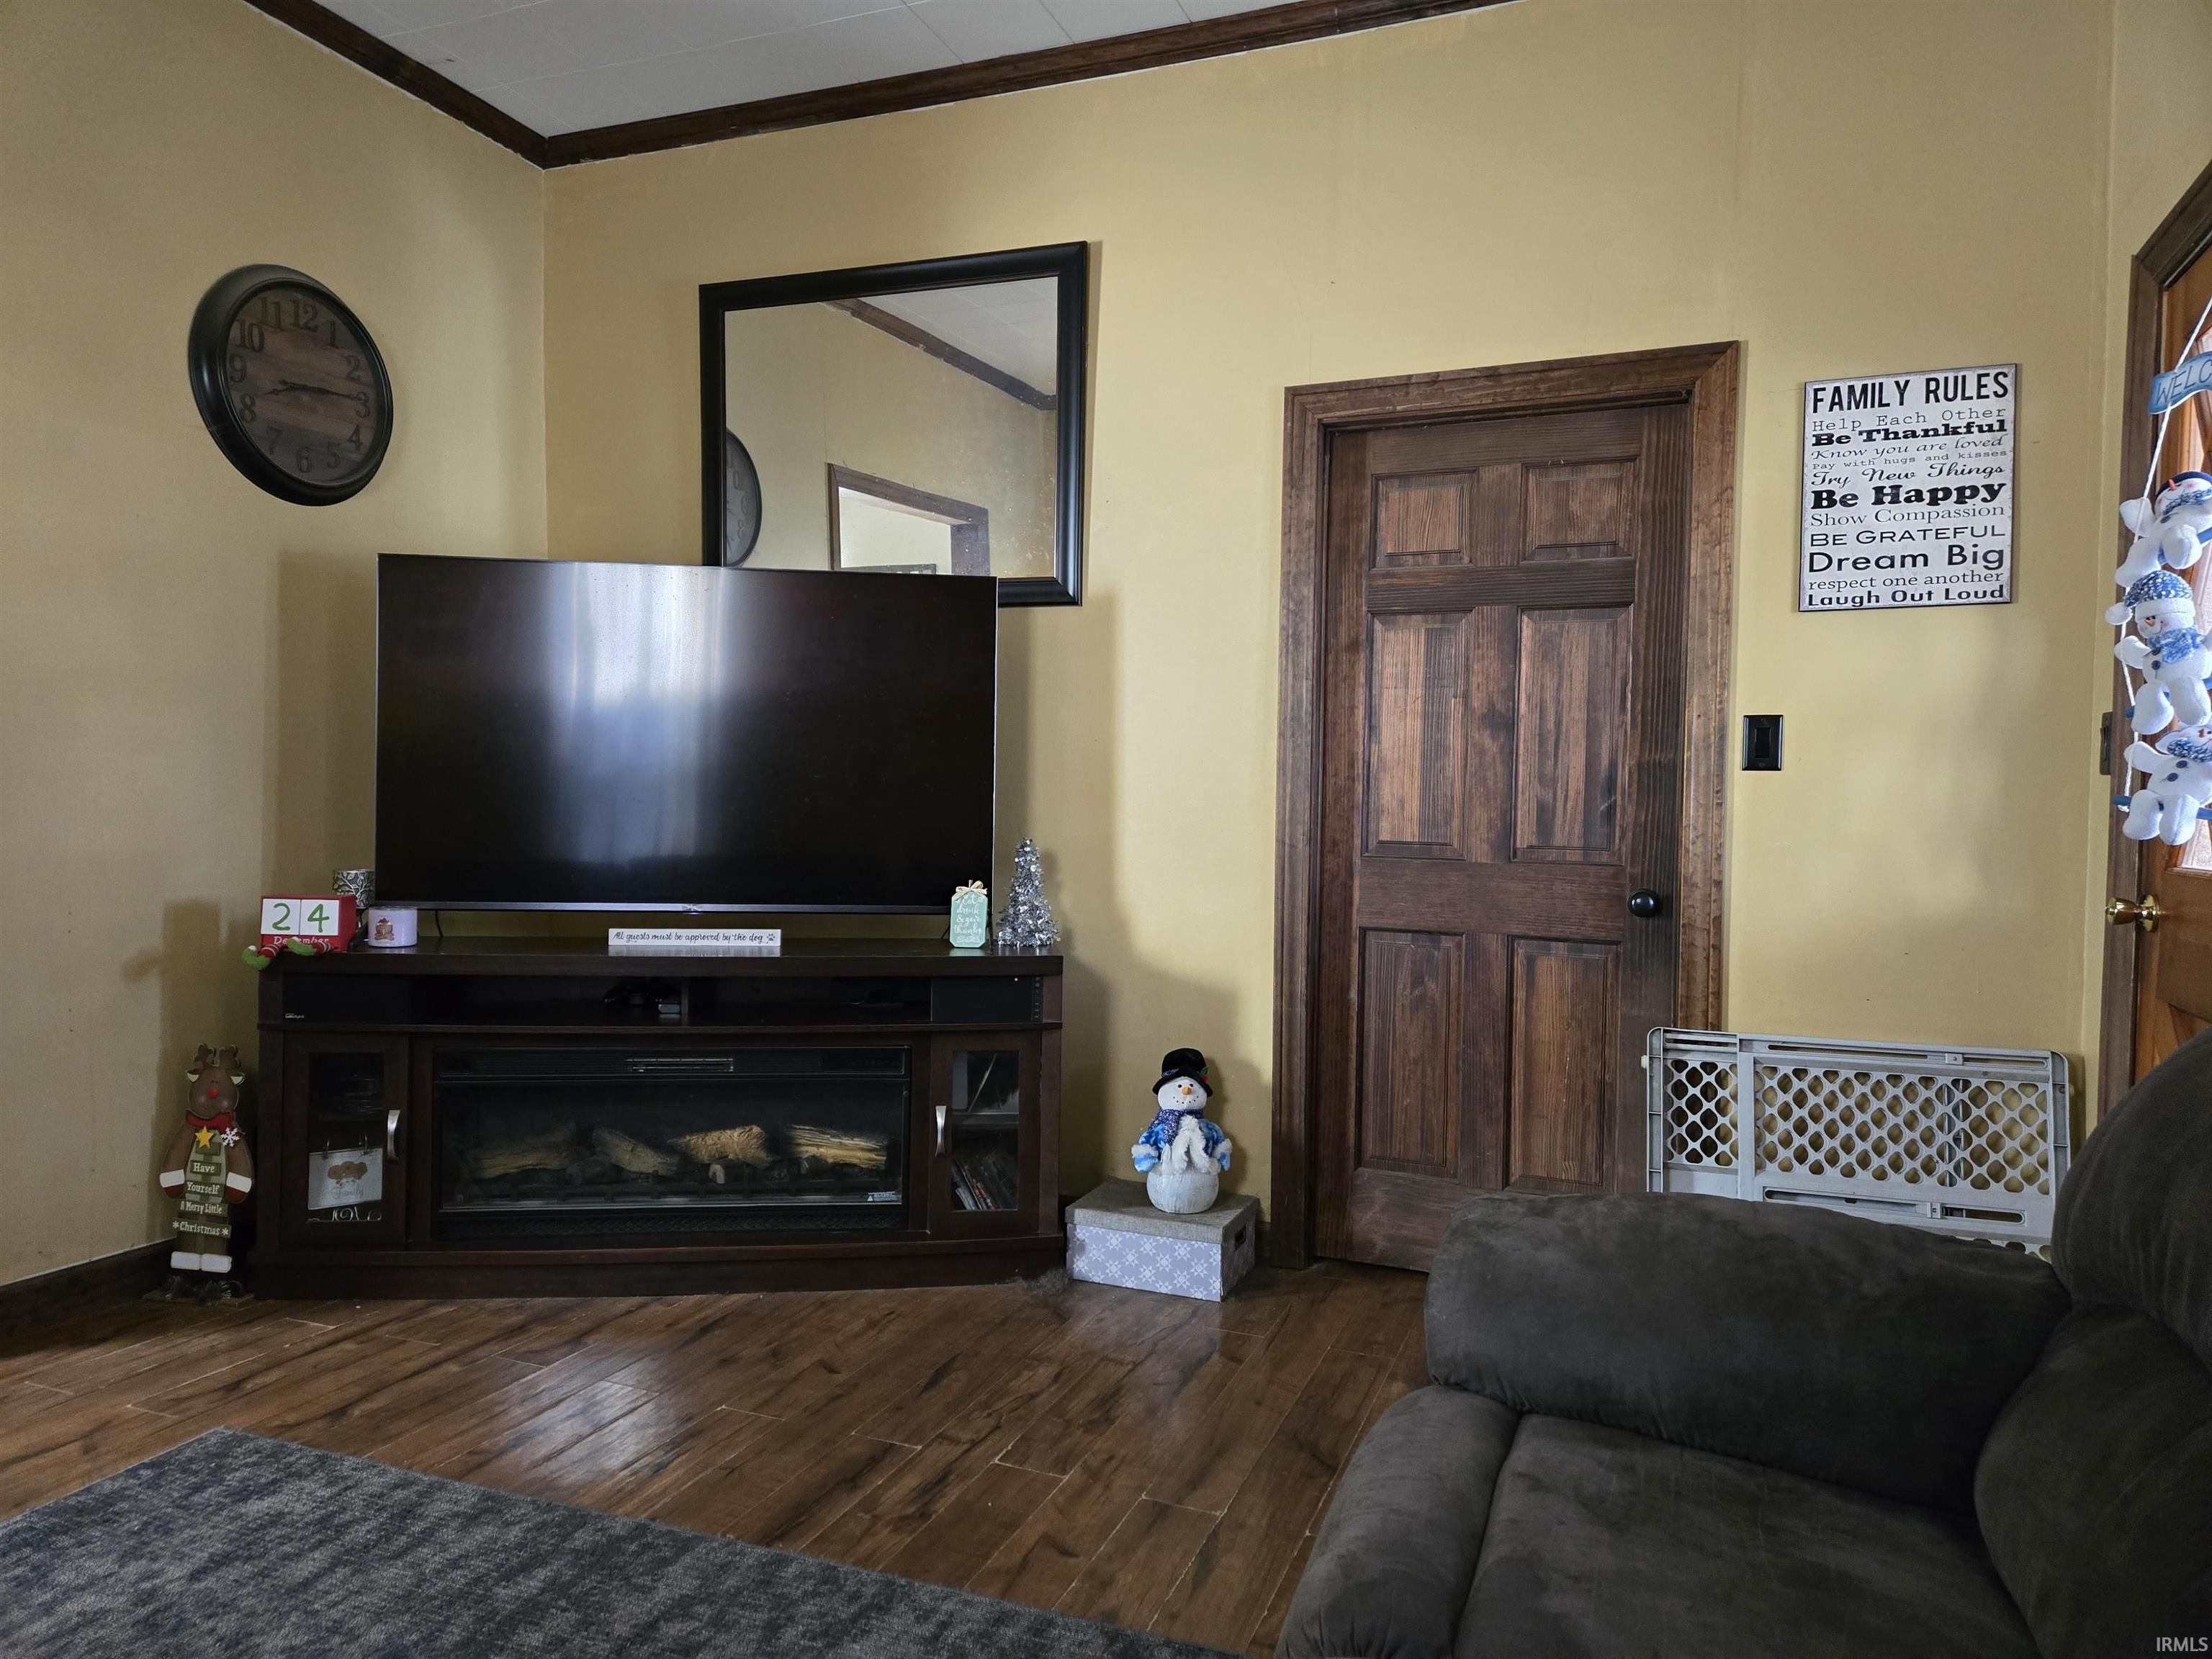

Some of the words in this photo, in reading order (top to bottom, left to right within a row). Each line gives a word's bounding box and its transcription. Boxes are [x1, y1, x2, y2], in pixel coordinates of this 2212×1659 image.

[259, 297, 286, 331] 11
[289, 300, 319, 333] 12
[235, 320, 264, 352] 10
[229, 354, 246, 382] 9
[345, 355, 367, 382] 2
[356, 392, 370, 418] 3
[1812, 379, 1910, 414] FAMILY
[1925, 372, 2008, 404] RULES
[239, 394, 256, 423] 8
[1813, 418, 1861, 432] Help
[1876, 412, 1927, 426] Each
[1942, 407, 2006, 421] Other
[266, 426, 284, 455] 7
[348, 425, 363, 451] 4
[1812, 432, 1852, 446] Be
[1858, 419, 2008, 443] Thankful
[295, 446, 312, 473] 6
[325, 441, 341, 468] 5
[1811, 448, 1867, 459] Know
[1873, 444, 1910, 459] you
[1917, 441, 1947, 453] are
[1954, 434, 2008, 449] loved
[1843, 459, 1876, 467] with
[1884, 456, 1915, 465] hugs
[1958, 450, 2006, 459] kisses
[1811, 472, 1851, 489] Try
[1861, 468, 1916, 482] New
[1928, 462, 2005, 480] Things
[1811, 488, 1859, 509] Be
[1871, 482, 2007, 506] Happy
[1811, 513, 1867, 526] Show
[1874, 504, 2005, 525] Compassion
[1810, 533, 1848, 547] BE
[1856, 525, 2005, 544] GRATEFUL
[1809, 552, 1929, 572] Dream
[1947, 544, 2005, 570] Big
[1808, 576, 1876, 592] respect
[1882, 576, 1918, 587] one
[1923, 570, 2004, 585] another
[1808, 590, 1881, 607] Laugh
[1891, 590, 1934, 603] Out
[1944, 584, 2005, 601] Loud
[626, 932, 649, 943] guests
[652, 932, 673, 940] must
[675, 932, 683, 940] be
[685, 932, 719, 943] approved
[722, 933, 731, 943] by
[194, 1163, 215, 1172] Have
[186, 1182, 220, 1194] Yourself
[186, 1201, 204, 1214] Merry
[205, 1203, 222, 1214] Little
[180, 1221, 220, 1236] Christmas
